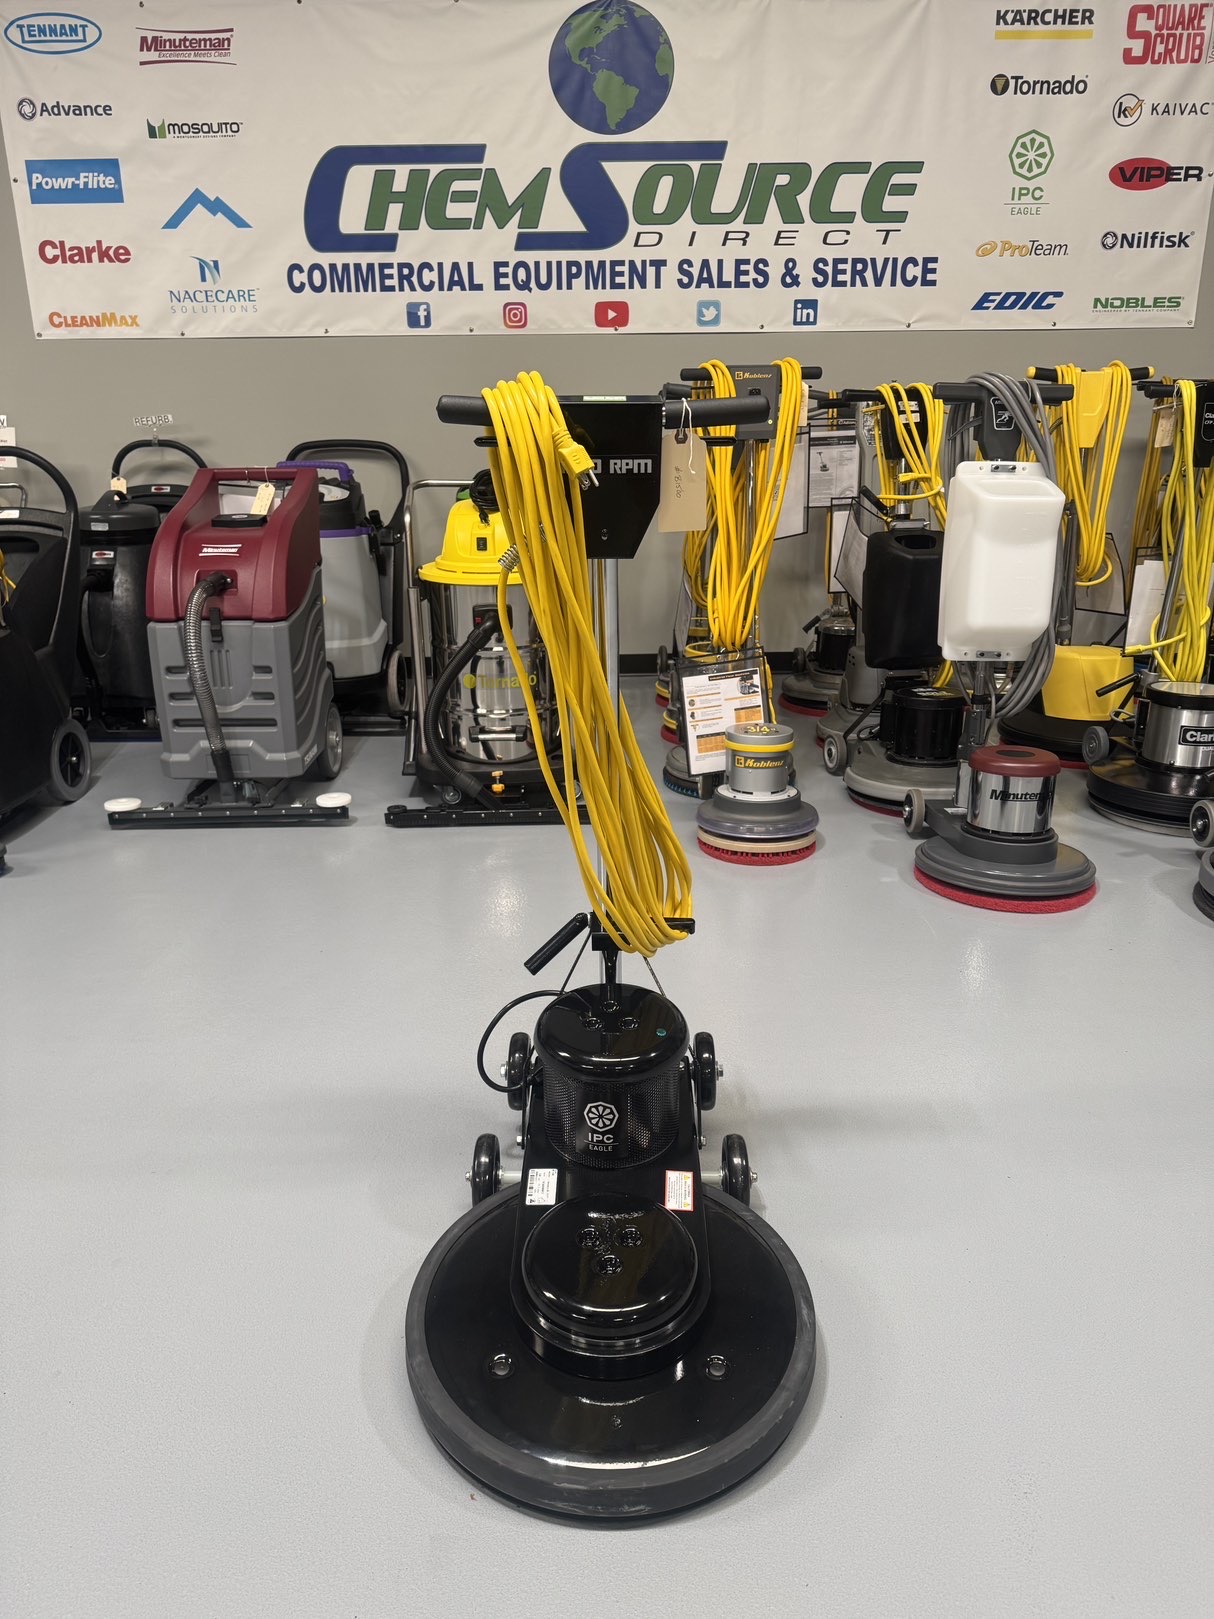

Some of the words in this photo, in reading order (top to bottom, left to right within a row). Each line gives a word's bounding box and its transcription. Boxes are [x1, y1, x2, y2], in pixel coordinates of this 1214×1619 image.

[995, 8, 1095, 26] KÄRCHER
[16, 23, 88, 44] TENNANT
[139, 35, 231, 52] Minuteman
[1010, 75, 1088, 95] Tornado
[39, 101, 113, 117] Advance
[1150, 102, 1210, 116] KAIVAC
[31, 172, 116, 190] Powr-Flite
[1118, 166, 1204, 183] VIPER
[1010, 186, 1044, 202] IPC
[1010, 206, 1042, 216] EAGLE
[633, 228, 901, 248] DIRECT
[1119, 232, 1191, 249] Nilfisk
[38, 240, 132, 264] Clarke
[998, 239, 1068, 258] ProTeam
[286, 261, 484, 293] COMMERCIAL
[493, 257, 668, 293] EQUIPMENT
[676, 257, 770, 290] SALES
[780, 257, 801, 289] &
[811, 256, 939, 288] SERVICE
[168, 288, 257, 303] NACECARE
[970, 291, 1065, 311] EDIC
[1092, 296, 1182, 309] NOBLES
[170, 304, 259, 314] SOLUTIONS
[609, 458, 653, 474] RPM
[477, 672, 538, 689] Tornao
[1185, 730, 1214, 742] Clar
[745, 758, 785, 769] Koblenz
[588, 1132, 614, 1143] IPC
[589, 1144, 613, 1152] EAGLE
